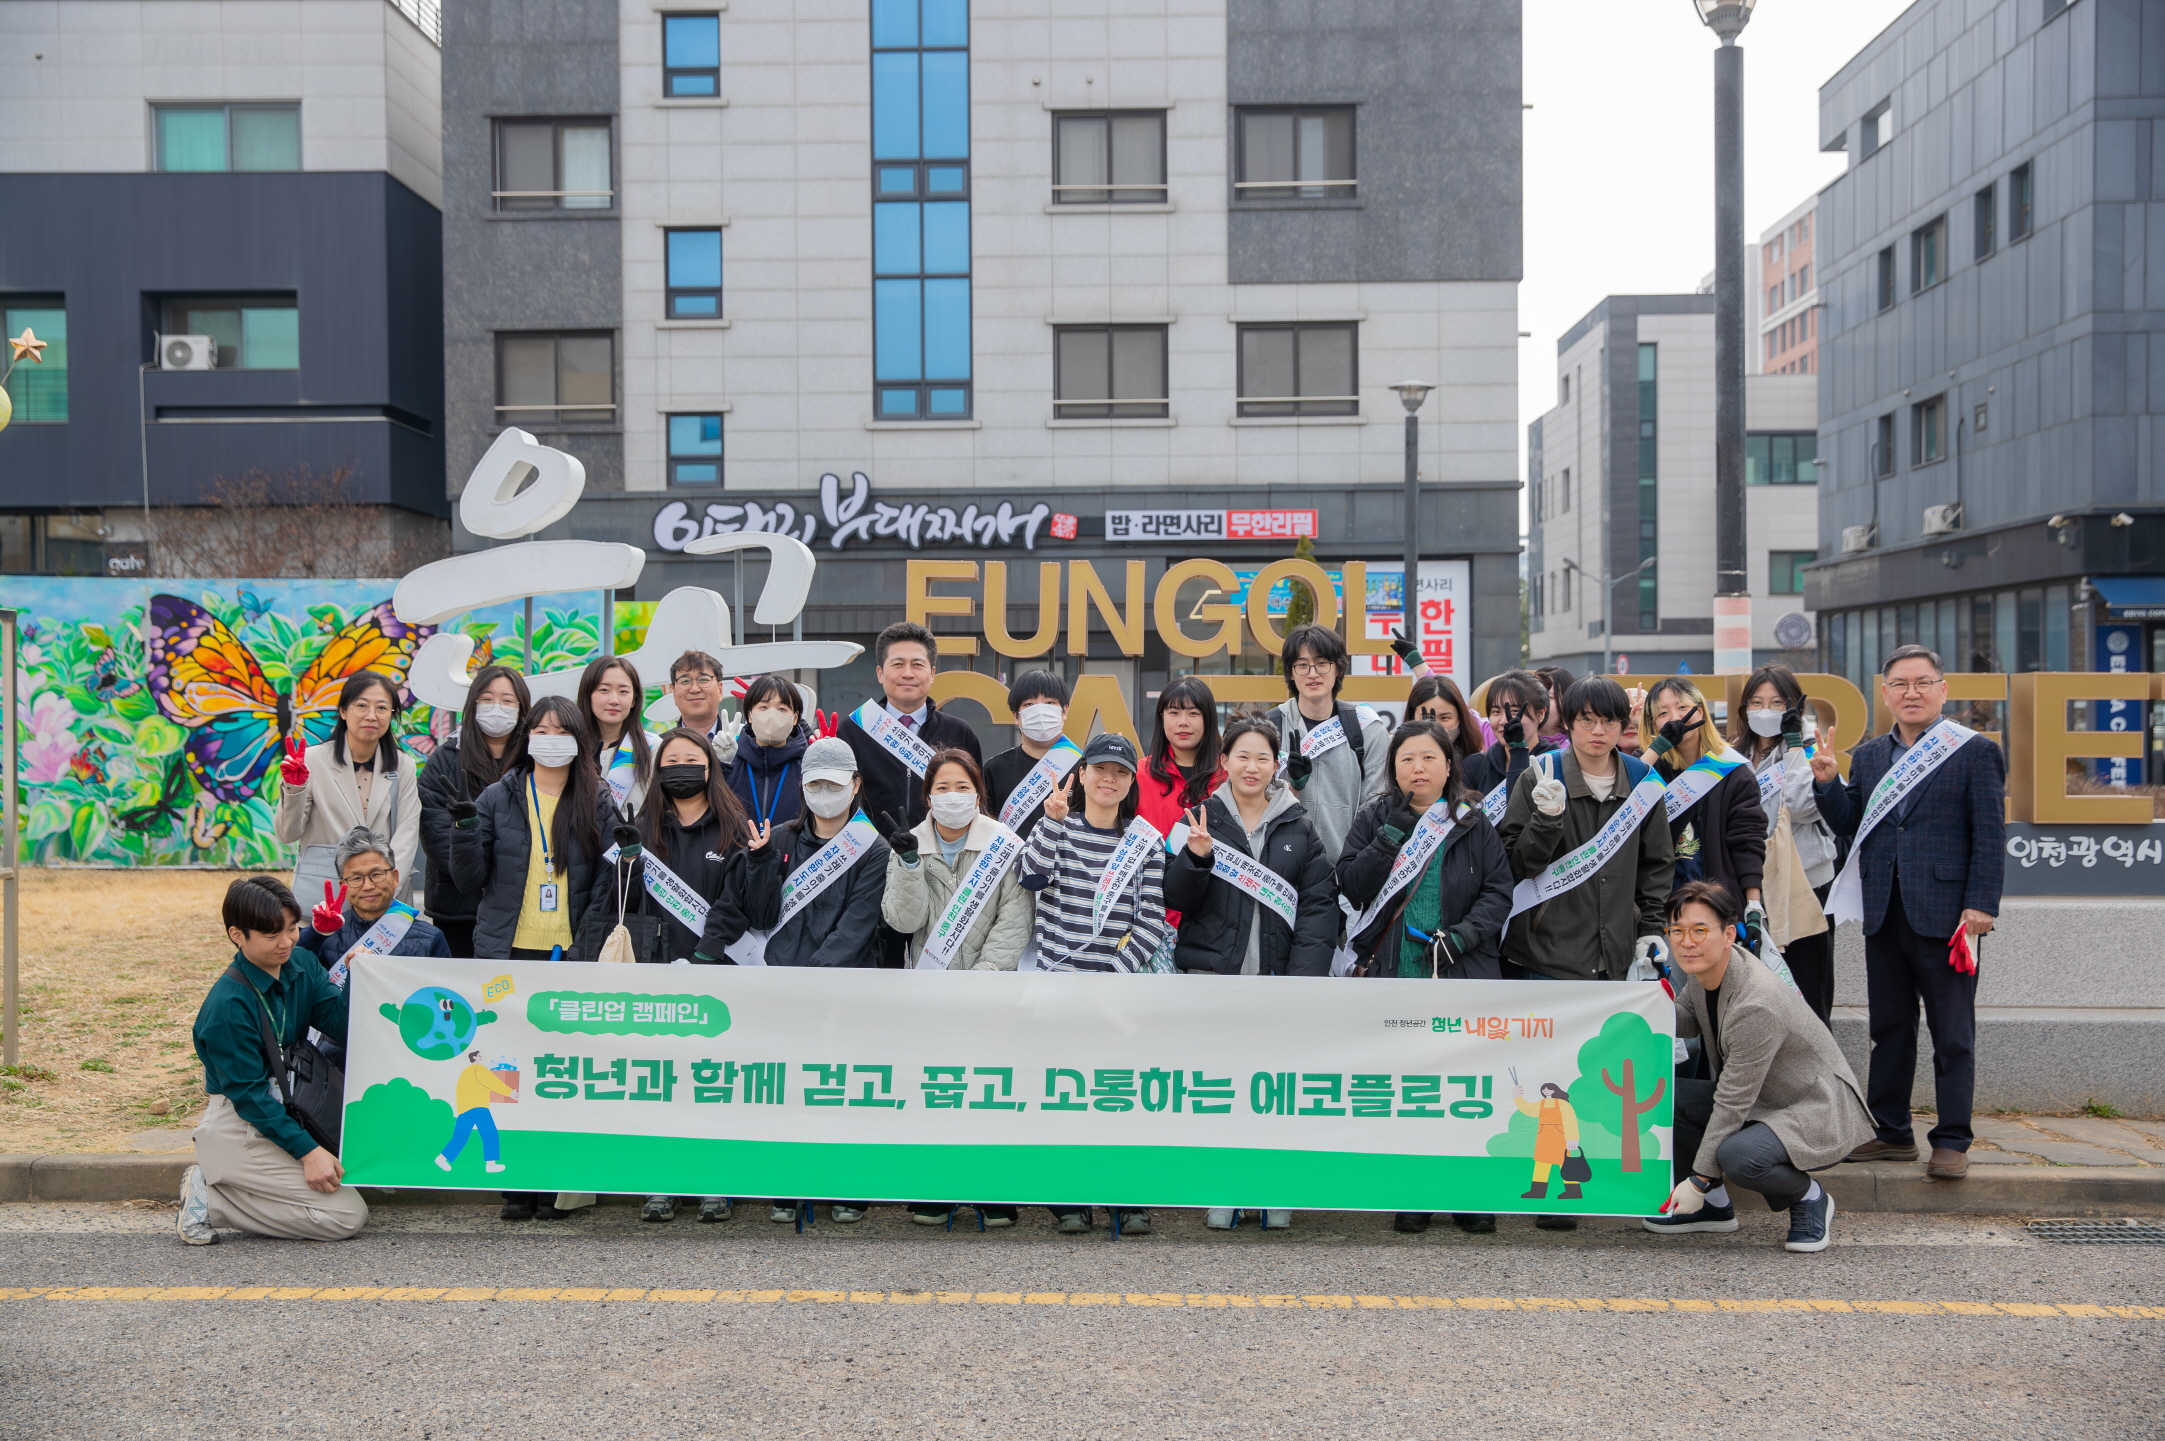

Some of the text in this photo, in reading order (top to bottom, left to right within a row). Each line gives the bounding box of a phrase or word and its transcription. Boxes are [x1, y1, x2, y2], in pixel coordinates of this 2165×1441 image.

[1230, 512, 1313, 536] 무한리필
[905, 557, 1405, 660] EUNGOL
[884, 734, 900, 748] 자원
[892, 726, 933, 762] 쓰레기 줄이기
[1922, 736, 1940, 753] 자원
[1925, 745, 1948, 766] 쓰레기
[1032, 780, 1050, 798] 쓰레기
[1488, 801, 1507, 821] 이기를
[1620, 805, 1632, 820] 자원
[1620, 815, 1638, 837] 쓰레기
[822, 844, 841, 862] 자원
[989, 836, 1005, 854] 자원
[1132, 838, 1148, 858] 쓰레기
[1420, 834, 1436, 854] 쓰레기
[2006, 835, 2163, 868] 인천광역시
[824, 854, 848, 876] 쓰레기
[995, 843, 1015, 868] 쓰레기
[795, 873, 827, 900] 줄이기를
[975, 867, 999, 901] 줄이기를
[1100, 870, 1115, 892] 쓰레기
[1237, 874, 1261, 892] 쓰레기
[958, 887, 973, 905] 클린
[947, 904, 962, 922] 인천
[942, 900, 980, 956] 생활화합시다!!
[487, 979, 510, 998] ECO
[533, 1052, 677, 1103] 청년과
[690, 1058, 787, 1106] 함께
[801, 1063, 907, 1110] 걷고,
[1040, 1067, 1236, 1114] 소통하는
[1249, 1071, 1494, 1120] 에코플로깅
